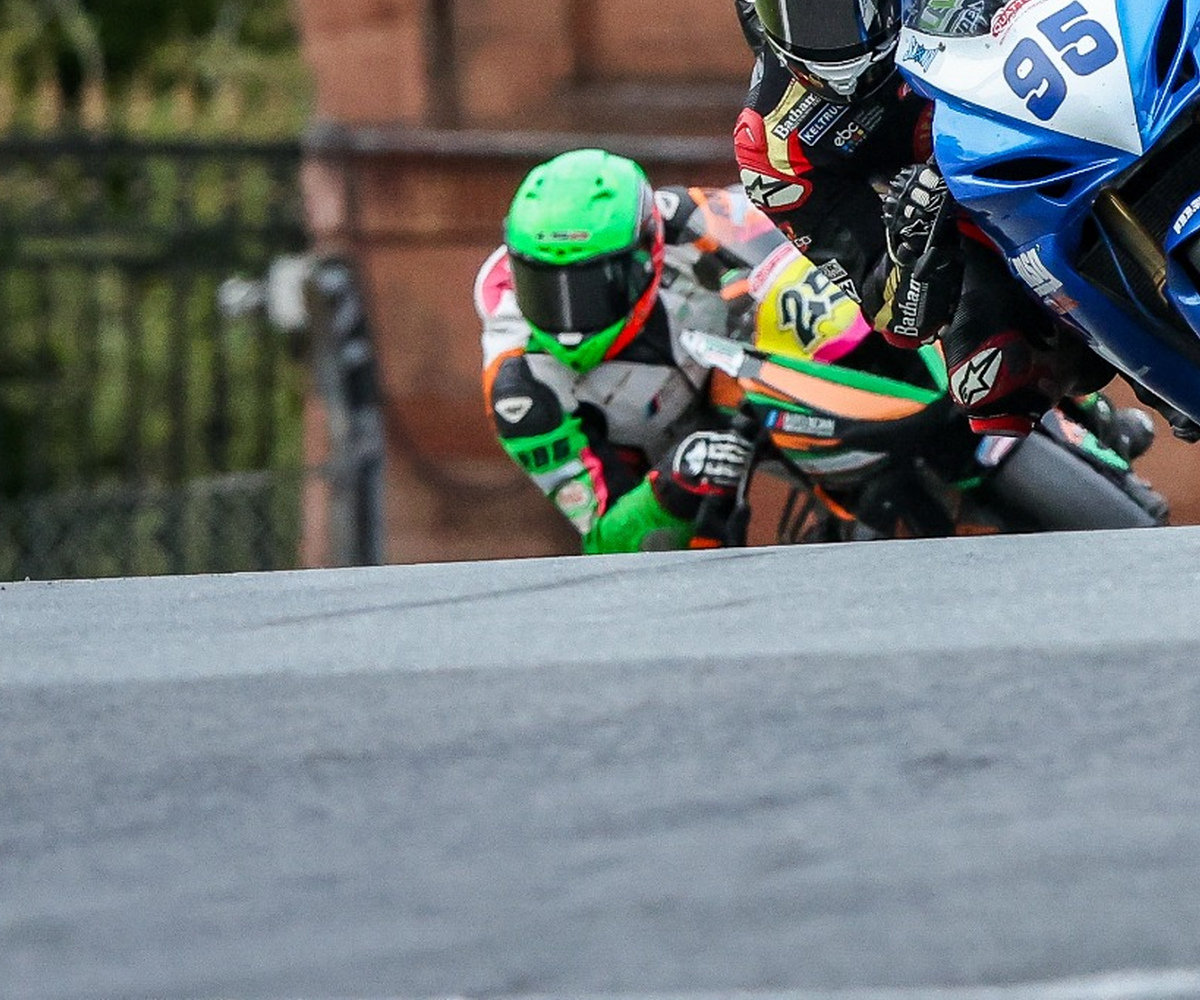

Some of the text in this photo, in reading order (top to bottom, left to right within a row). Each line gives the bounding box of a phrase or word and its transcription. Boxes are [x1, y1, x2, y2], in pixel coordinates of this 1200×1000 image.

[1003, 1, 1118, 121] 95
[804, 105, 843, 141] KELTRU
[834, 121, 859, 147] ebc
